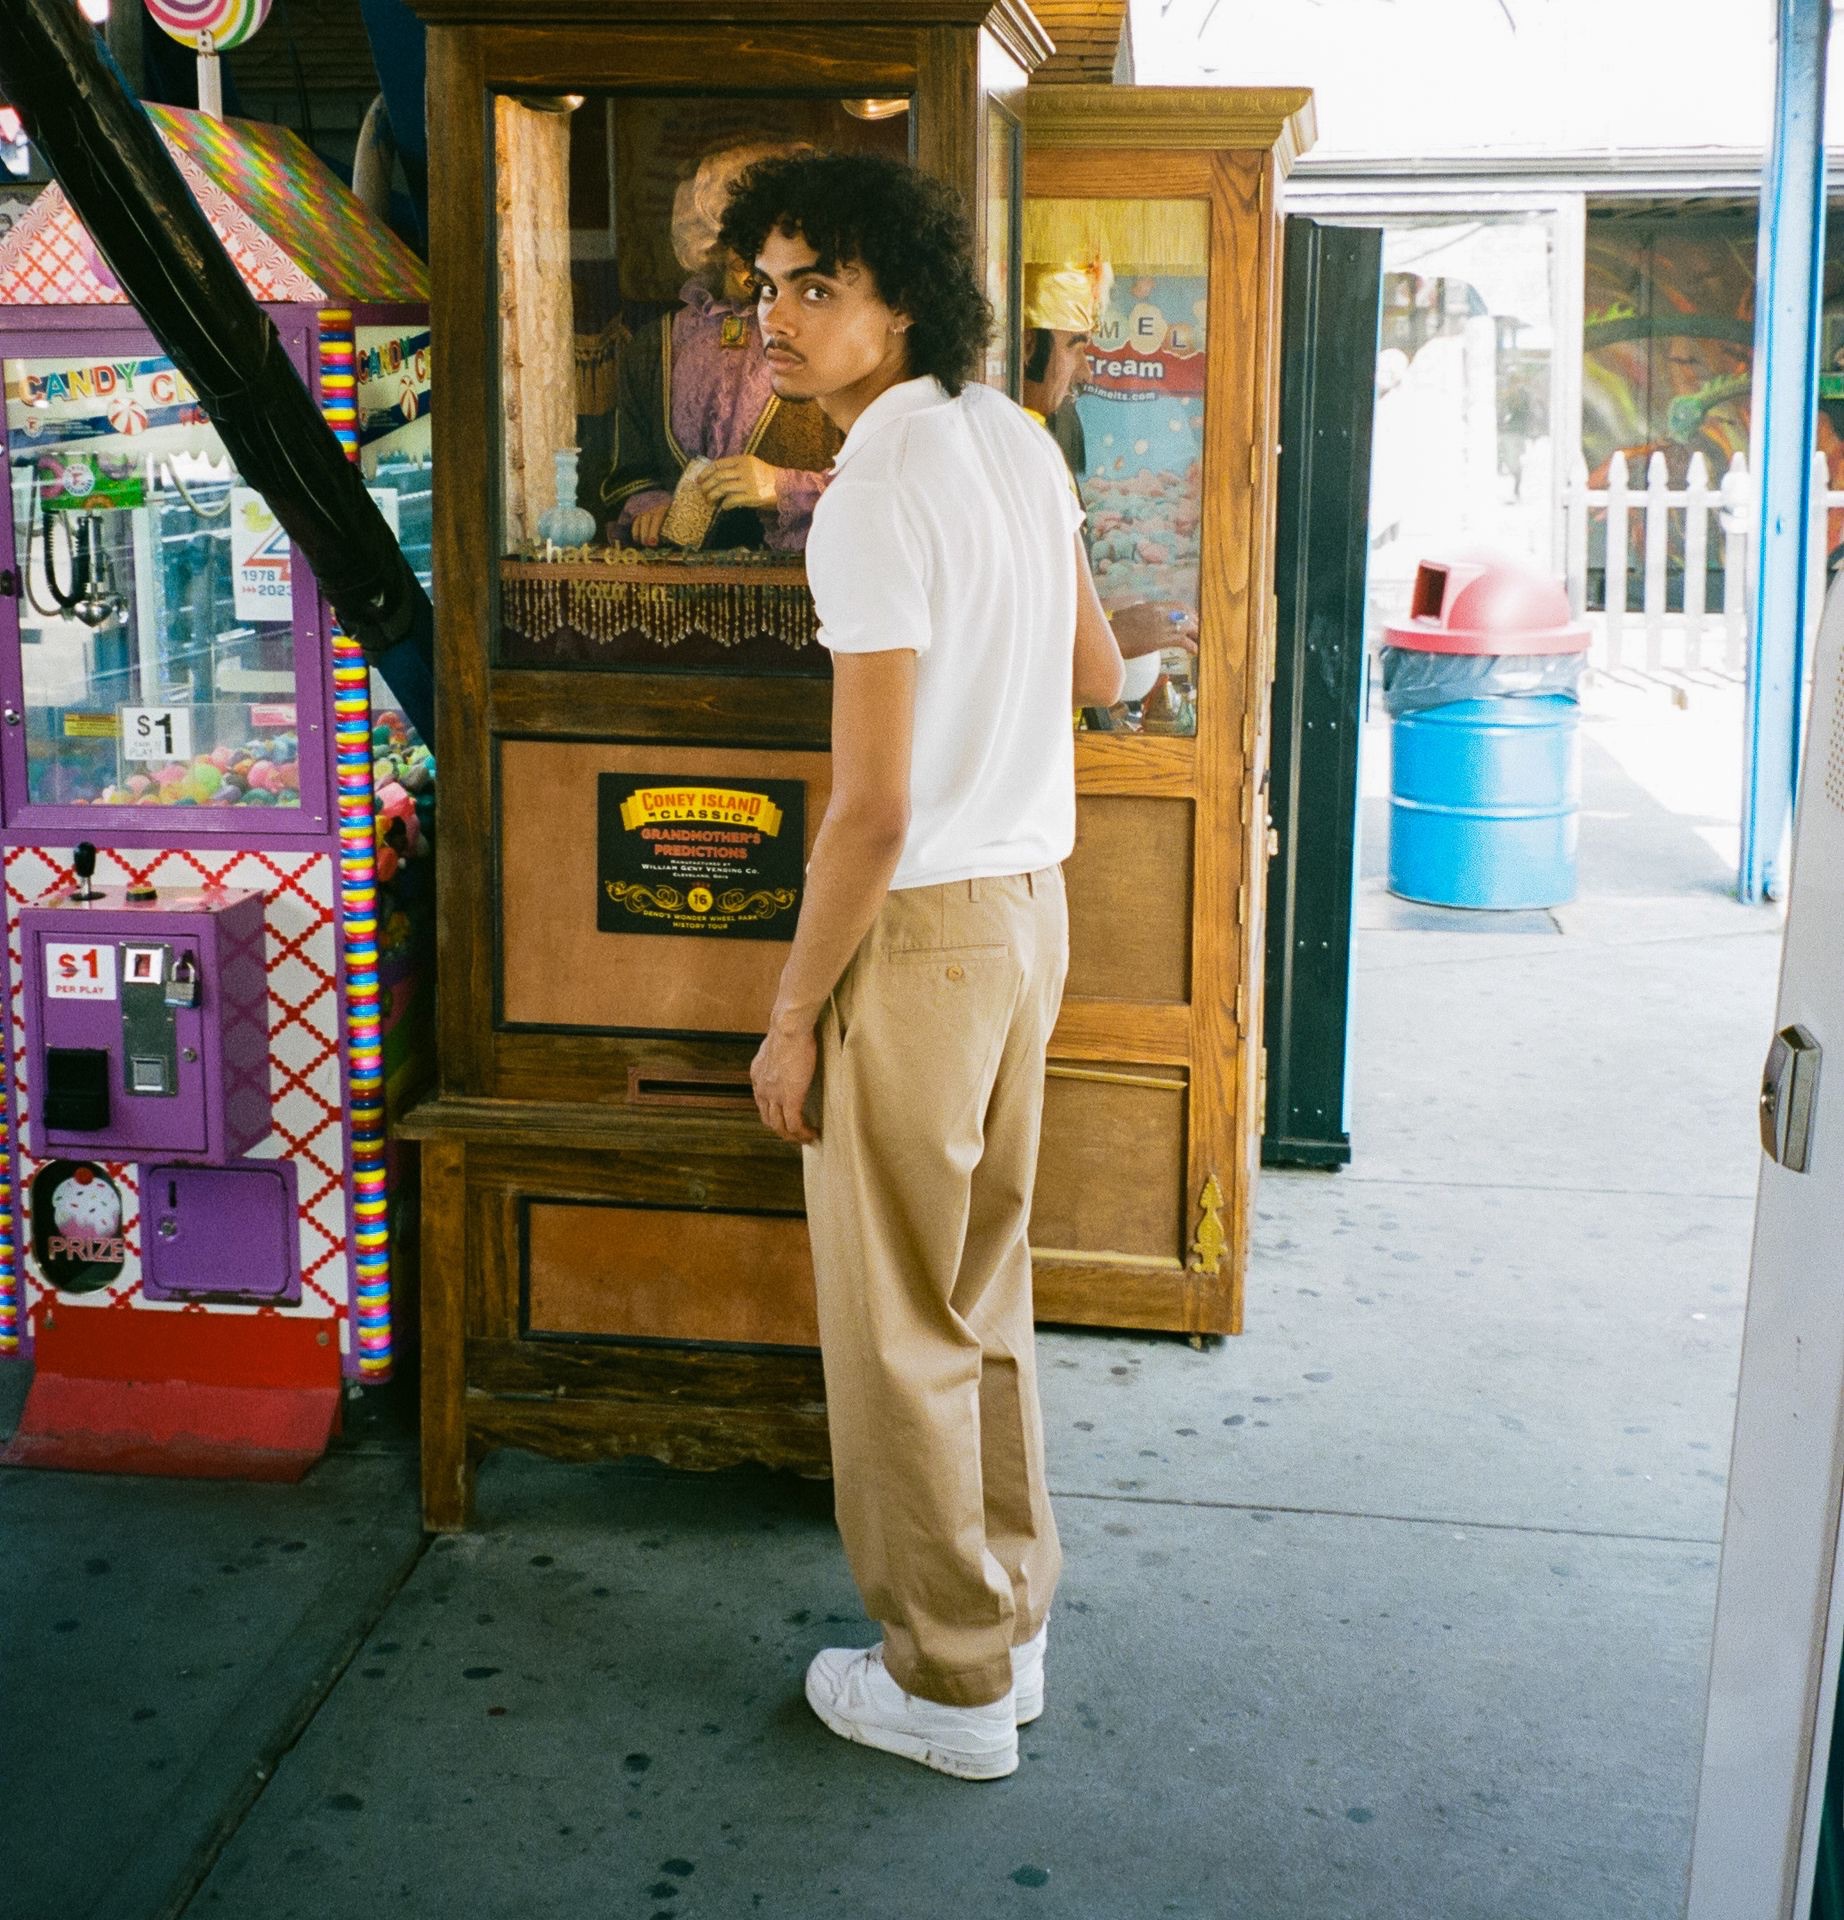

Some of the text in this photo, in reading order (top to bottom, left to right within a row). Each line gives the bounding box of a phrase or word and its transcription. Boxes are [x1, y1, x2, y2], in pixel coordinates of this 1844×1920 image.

[357, 336, 410, 386] CANDY
[19, 361, 139, 408] CANDY
[241, 570, 275, 582] 1978
[137, 713, 174, 754] $1
[642, 792, 761, 815] CONEY ISLAND
[660, 810, 743, 822] CLASSIC
[641, 828, 761, 844] GRANDMOTHER'S
[654, 844, 748, 859] PREDICTIONS
[694, 894, 707, 905] 16
[672, 921, 705, 929] HISTORY
[58, 948, 98, 979] $1
[55, 985, 104, 994] PER PLAY
[48, 1235, 125, 1263] PRIZE
